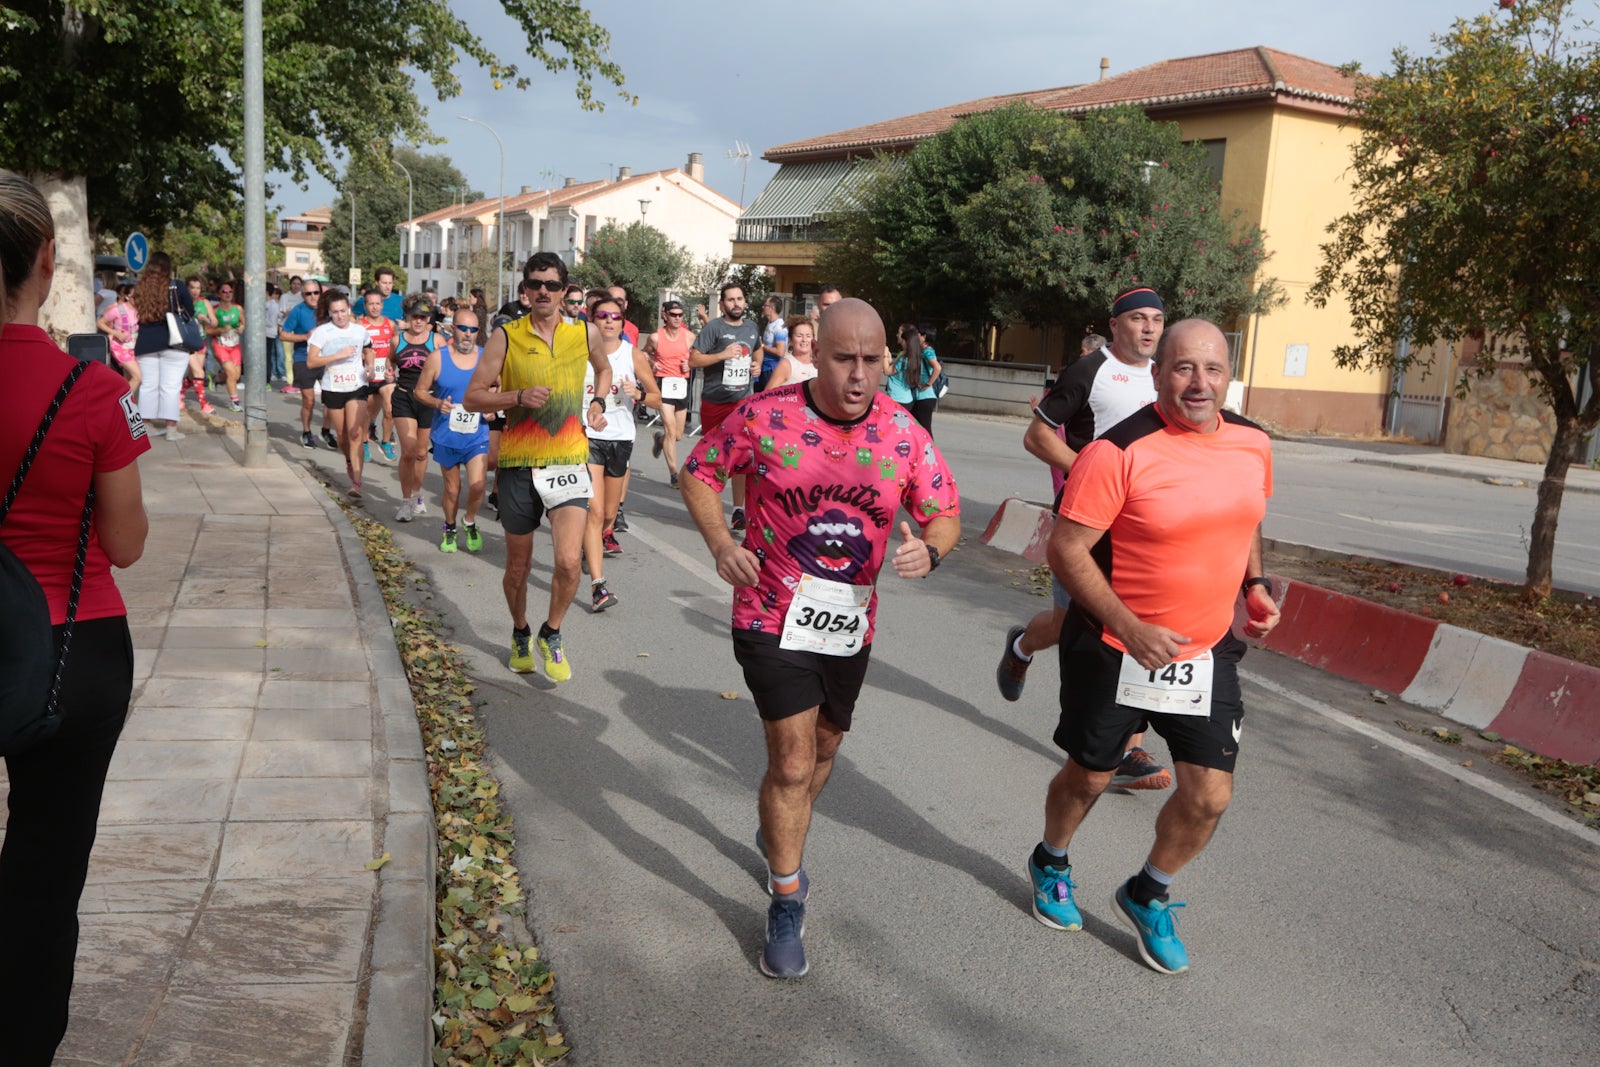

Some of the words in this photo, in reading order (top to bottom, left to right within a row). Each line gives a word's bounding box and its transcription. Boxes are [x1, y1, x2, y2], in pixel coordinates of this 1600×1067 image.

[333, 373, 357, 383] 2140
[727, 368, 749, 378] 3125
[586, 384, 619, 395] 29
[672, 383, 678, 391] 5
[455, 411, 476, 423] 327
[545, 473, 579, 490] 760
[795, 606, 860, 635] 3054
